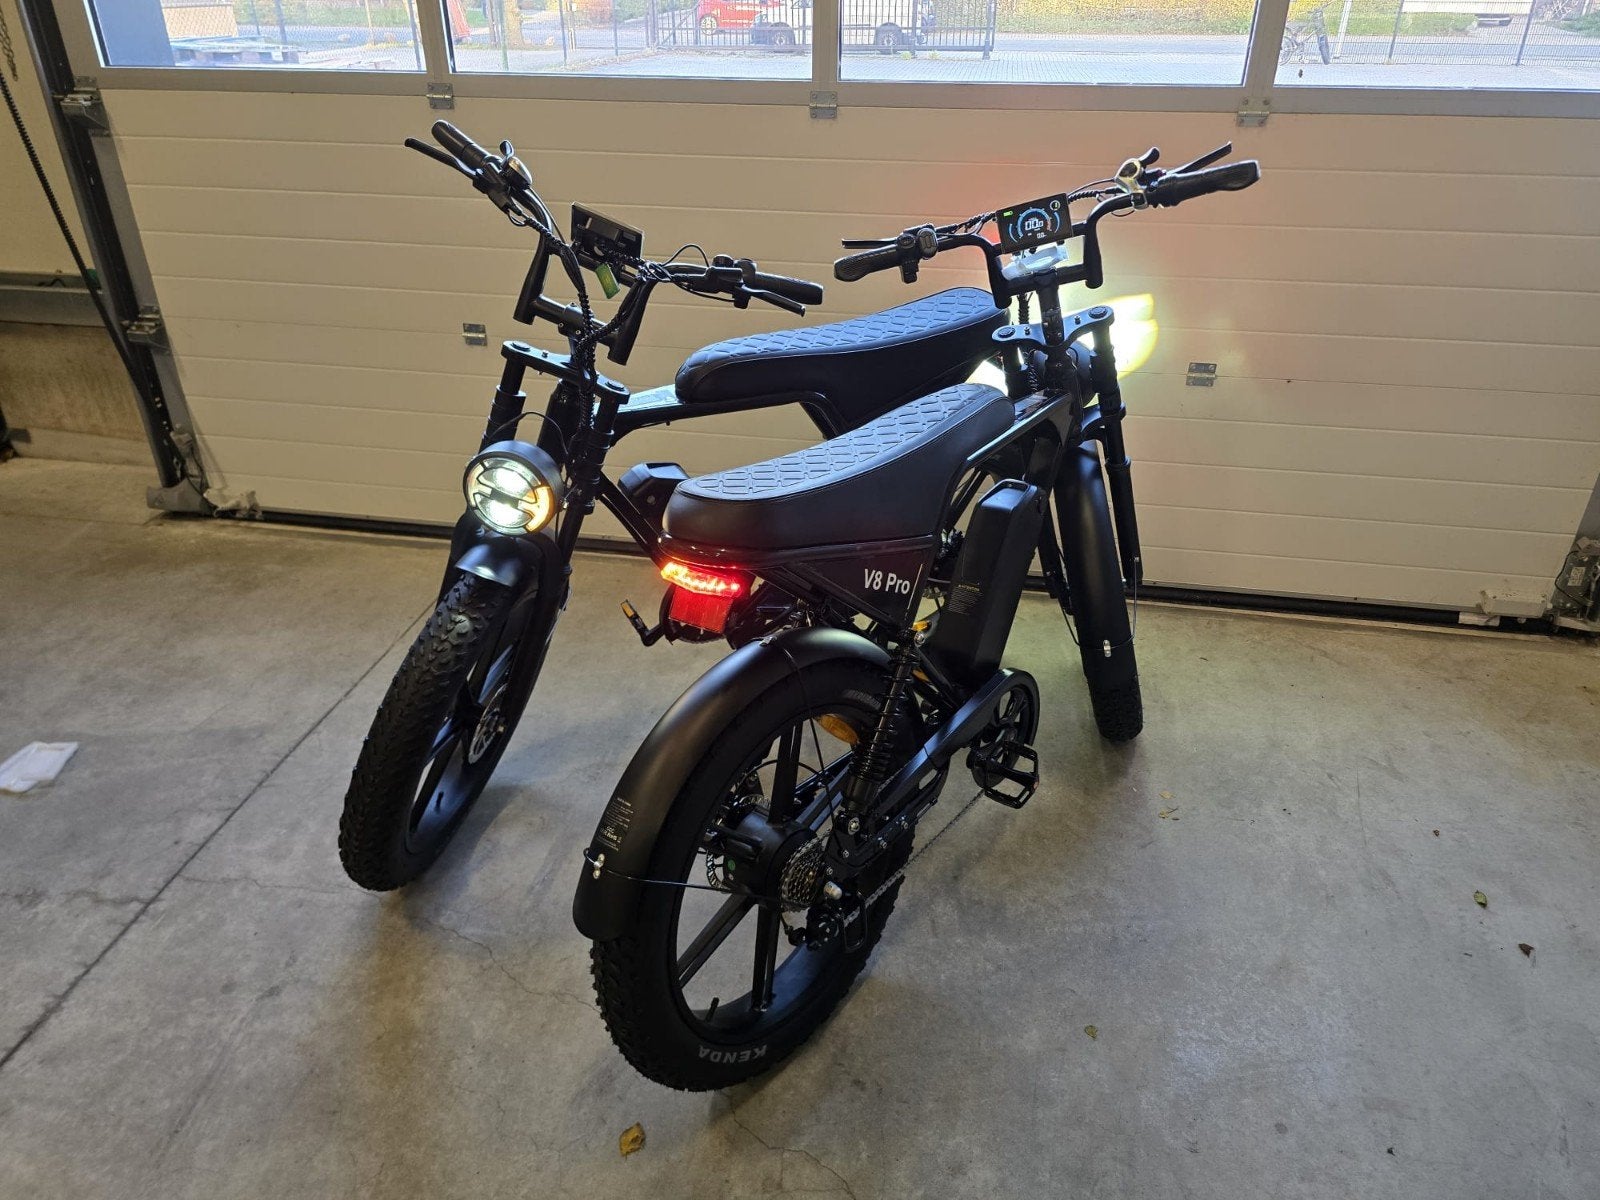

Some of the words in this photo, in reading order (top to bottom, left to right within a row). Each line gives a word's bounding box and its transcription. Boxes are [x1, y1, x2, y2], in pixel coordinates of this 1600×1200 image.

[864, 568, 883, 590] V8
[885, 572, 911, 595] Pro
[698, 1044, 768, 1064] KENDA
